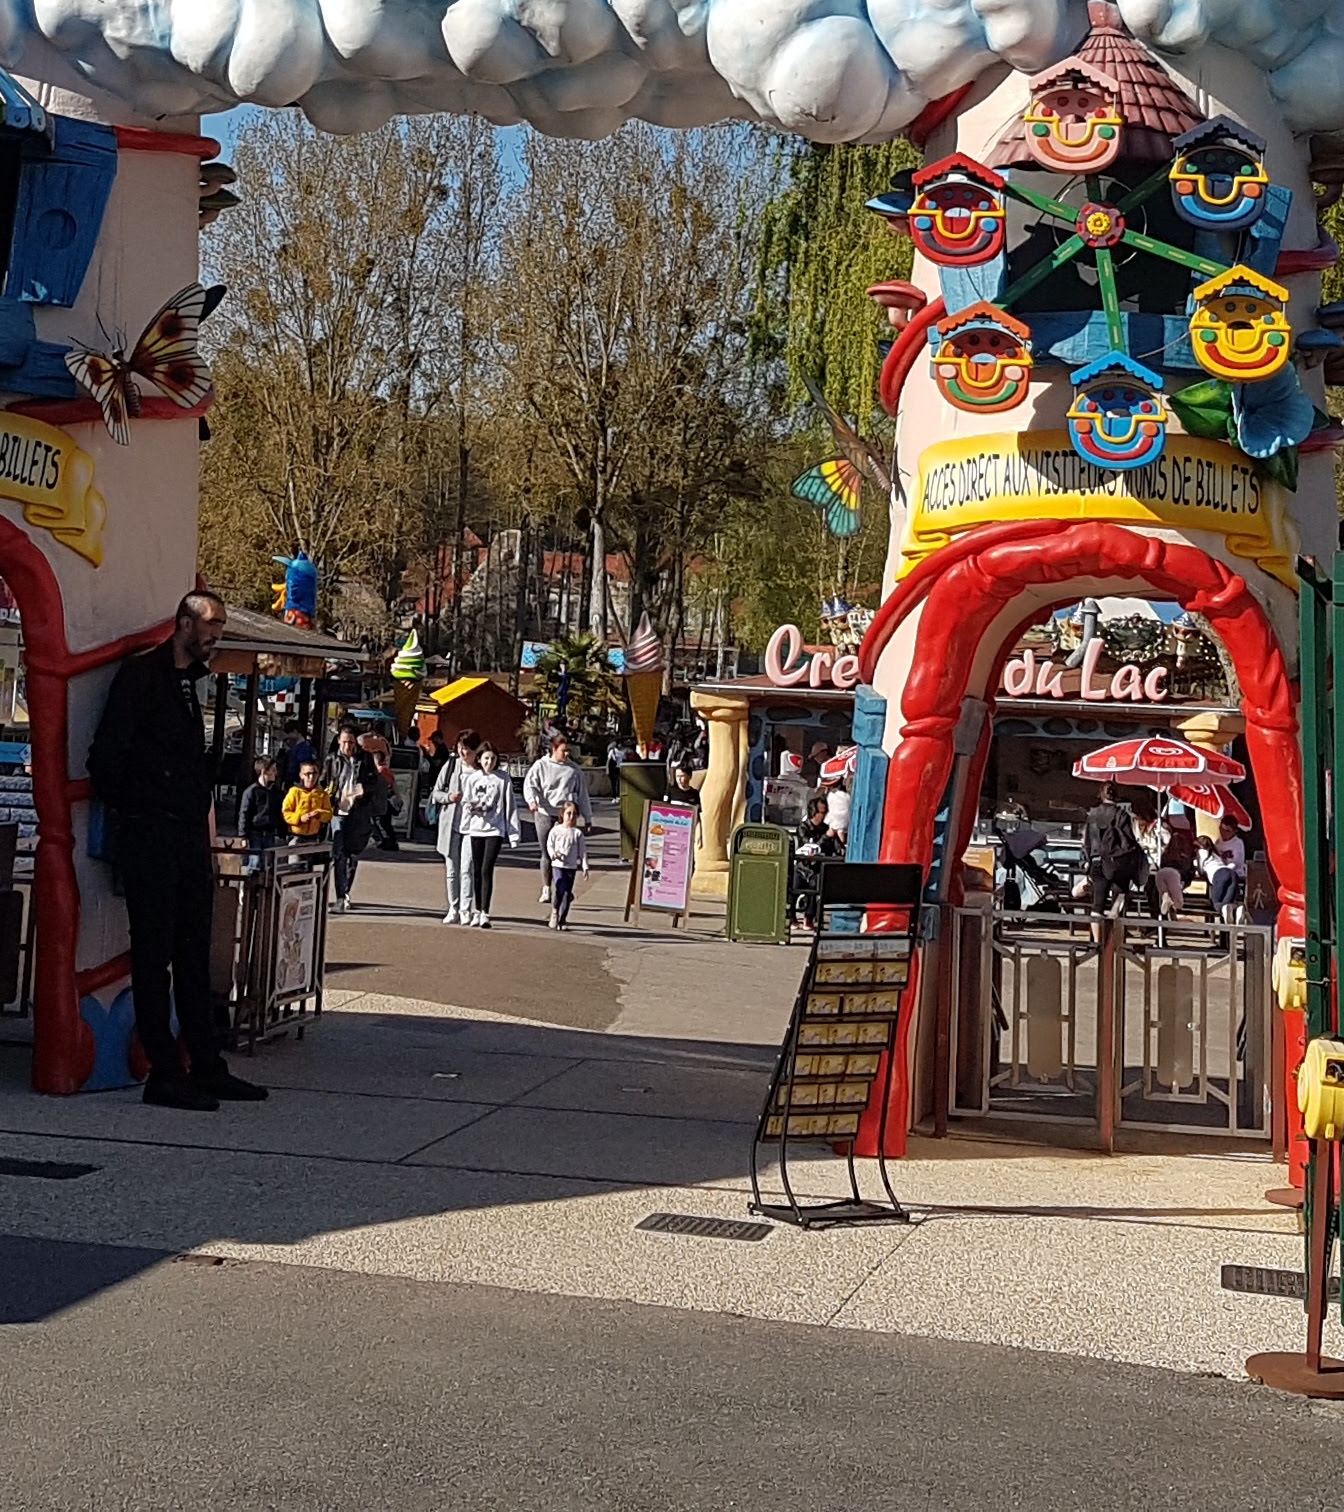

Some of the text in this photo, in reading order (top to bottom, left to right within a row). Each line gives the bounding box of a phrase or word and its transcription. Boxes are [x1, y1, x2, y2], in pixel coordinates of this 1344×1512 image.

[921, 462, 957, 514] ACCES
[958, 453, 1000, 507] DIRECT
[1002, 449, 1031, 497] AUX
[1171, 455, 1193, 506] DE
[1195, 458, 1260, 515] BILLETS
[1004, 649, 1064, 698] du
[1081, 638, 1168, 702] Lac
